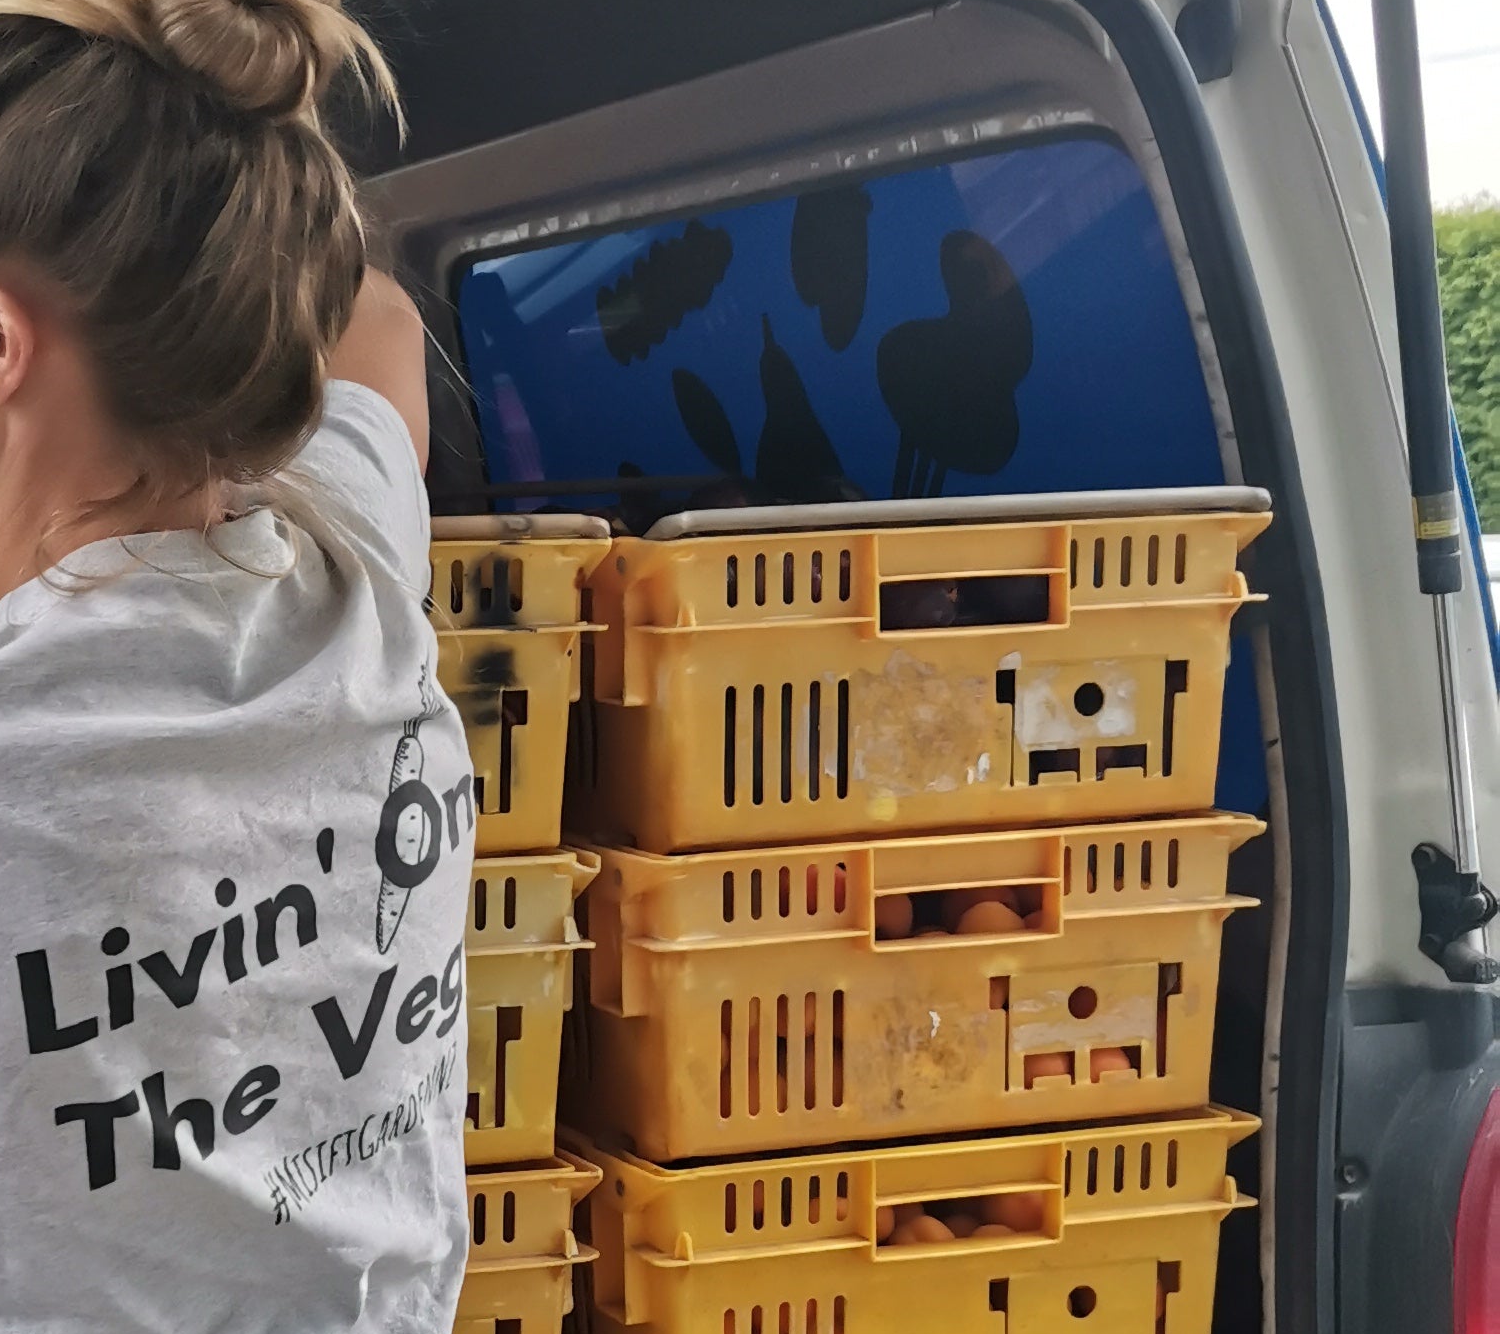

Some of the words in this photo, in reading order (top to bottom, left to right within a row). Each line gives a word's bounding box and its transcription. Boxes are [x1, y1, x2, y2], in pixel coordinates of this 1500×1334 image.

[14, 827, 336, 1055] Livin'
[374, 778, 474, 889] On
[54, 1064, 281, 1192] The
[310, 940, 463, 1081] Veg
